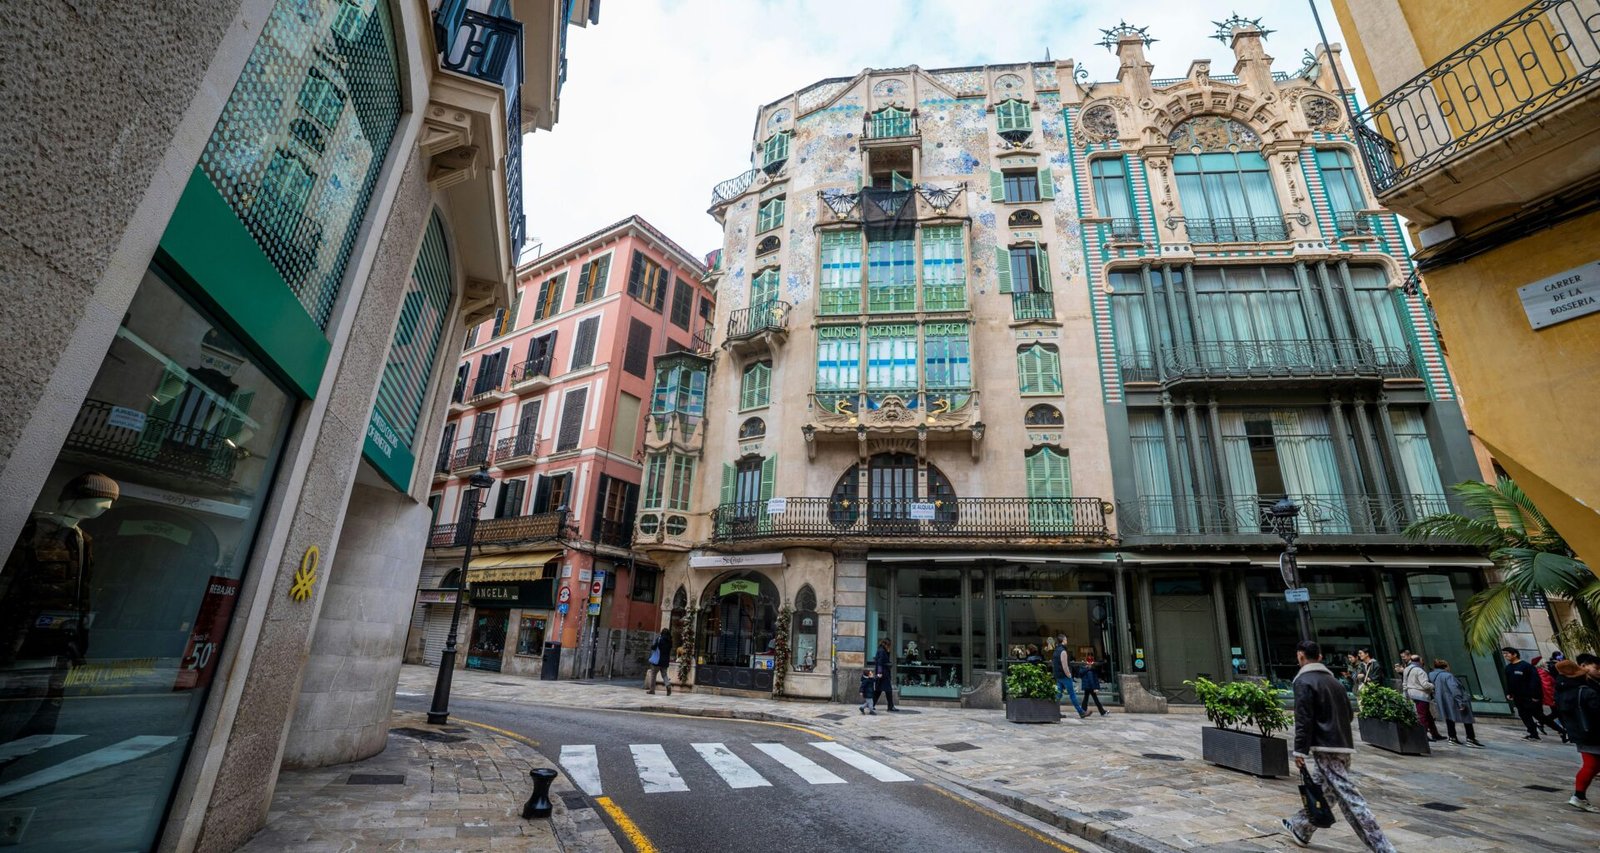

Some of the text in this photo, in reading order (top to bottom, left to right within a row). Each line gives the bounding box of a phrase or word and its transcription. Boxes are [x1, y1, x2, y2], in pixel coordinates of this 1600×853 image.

[1544, 275, 1582, 292] CARRER
[1553, 288, 1582, 302] DE LA
[1550, 297, 1596, 315] BOSSERIA
[871, 324, 914, 336] DENTAL
[209, 583, 236, 596] REBAJAS
[476, 588, 508, 599] ANGELA
